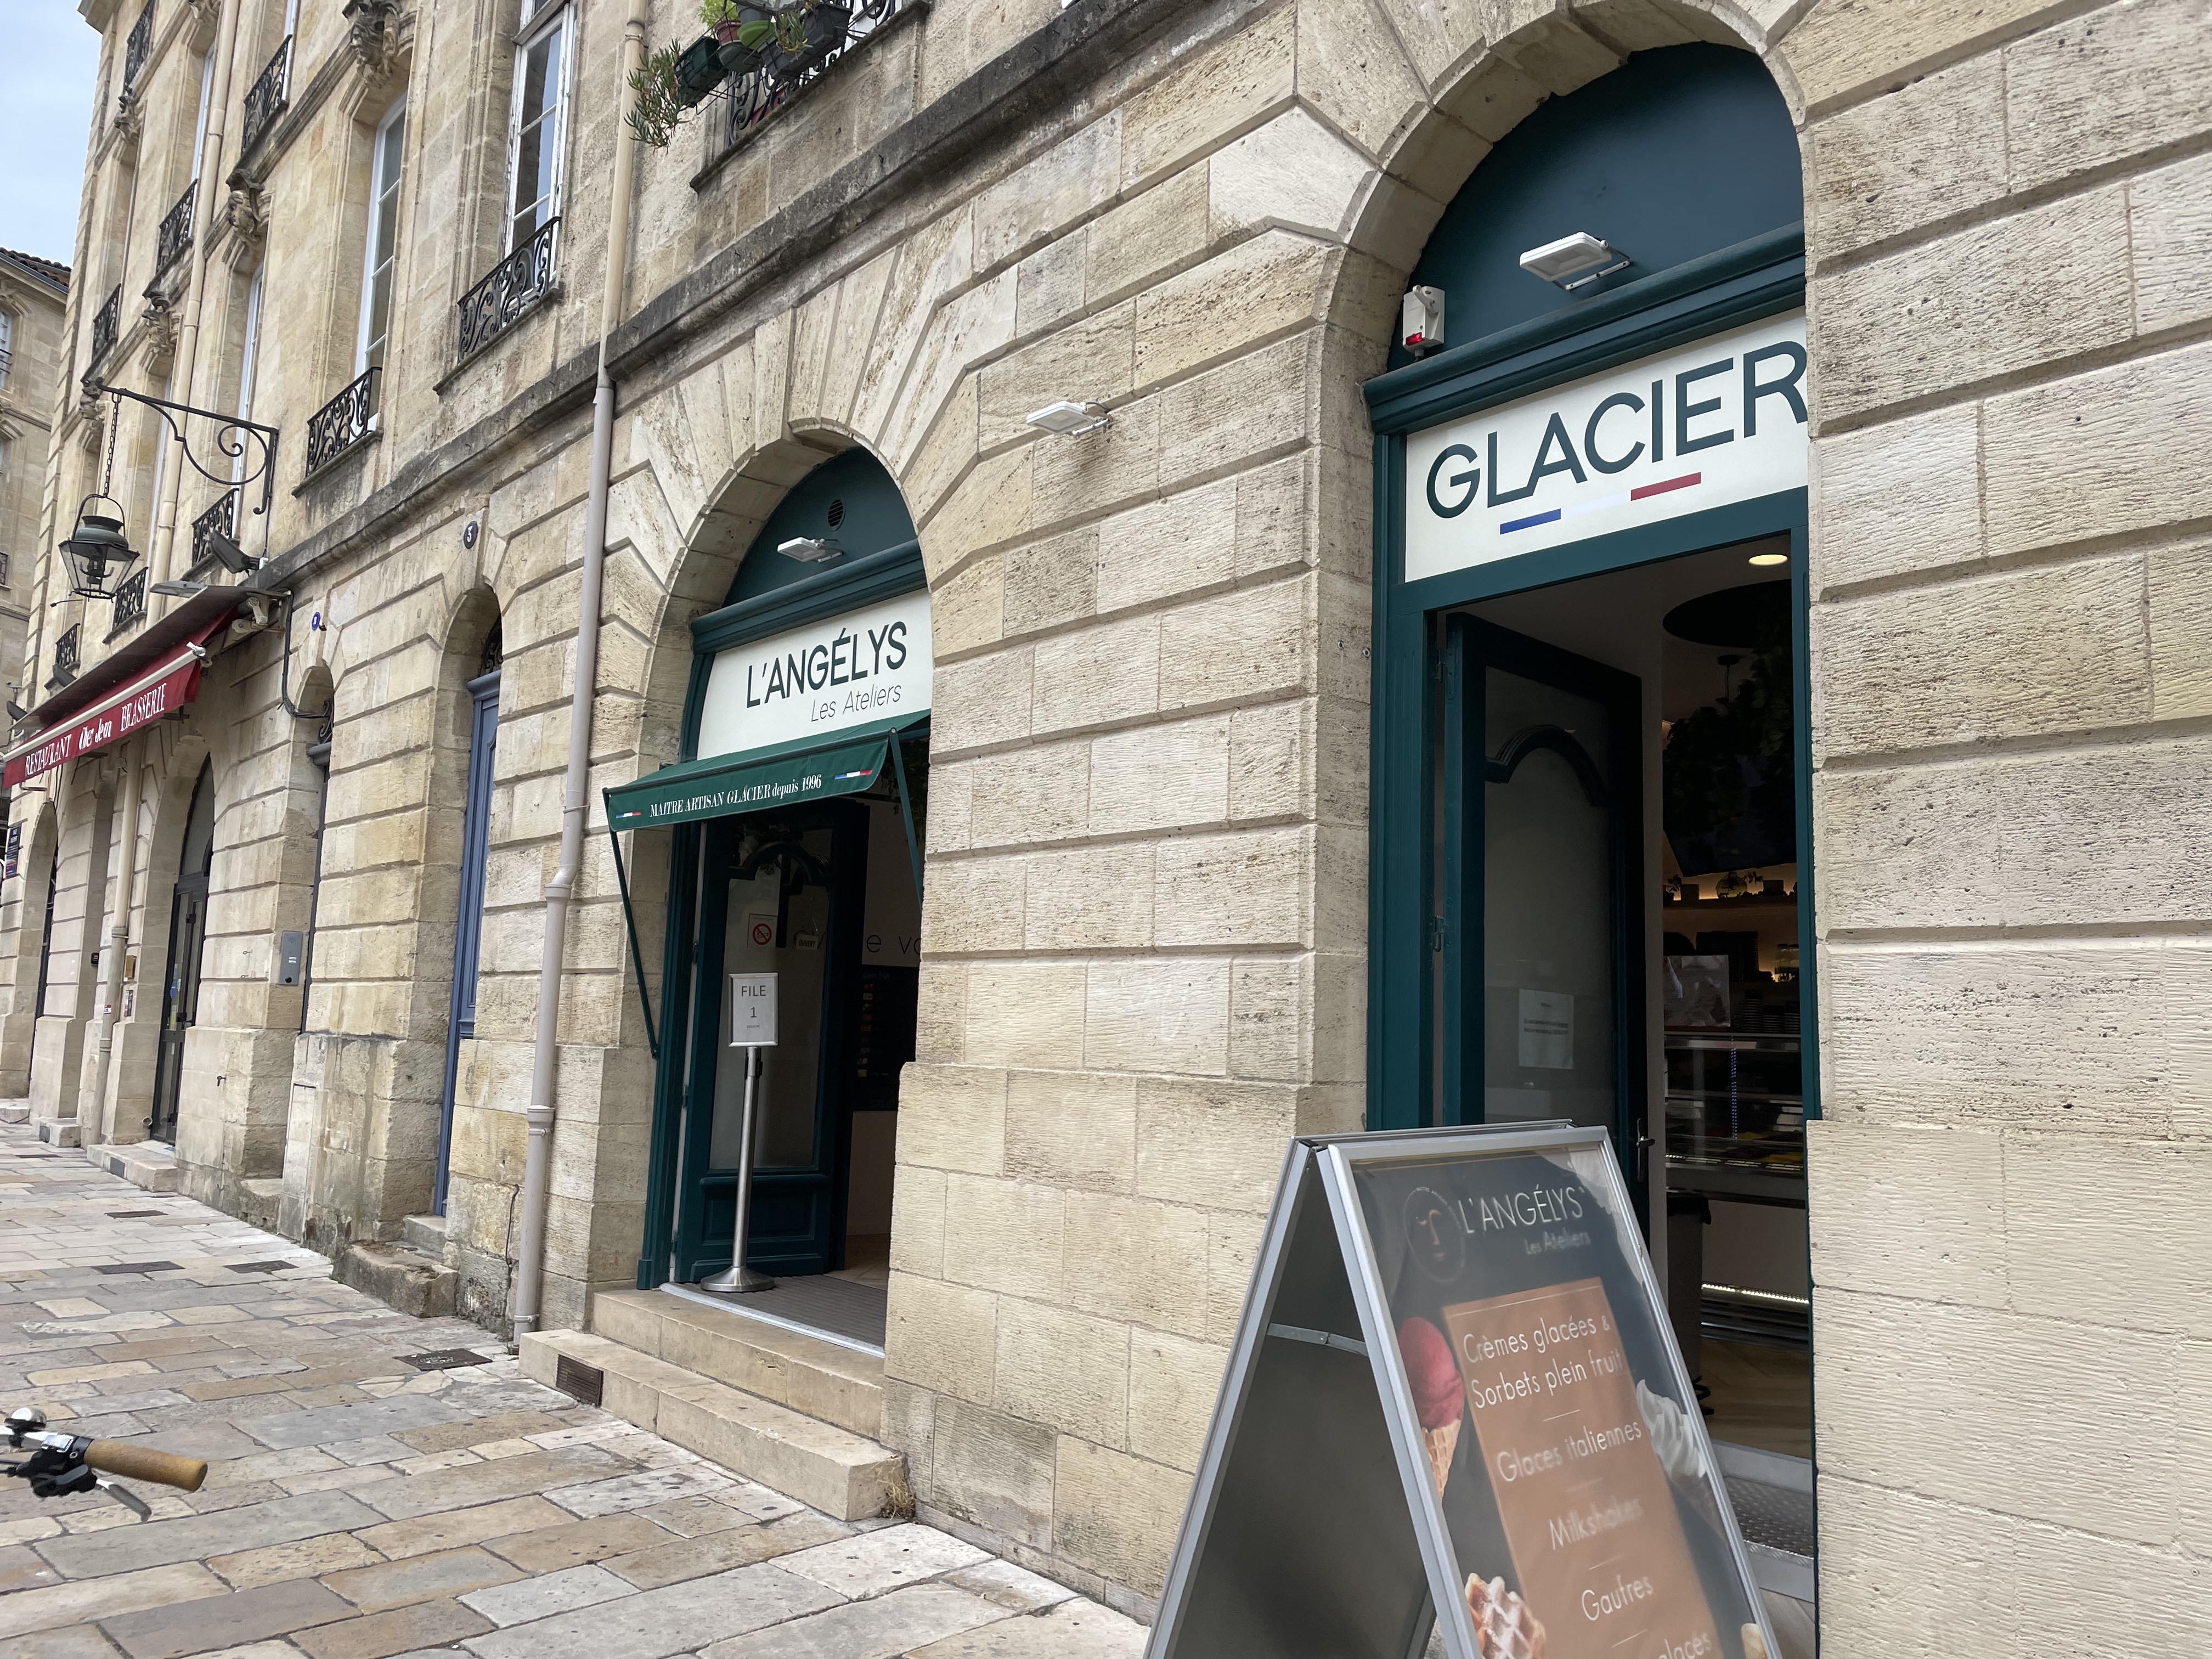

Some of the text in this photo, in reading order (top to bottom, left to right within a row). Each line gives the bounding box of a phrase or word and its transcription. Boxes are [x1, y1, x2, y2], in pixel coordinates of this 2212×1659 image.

[1426, 340, 1808, 519] GLACIER
[467, 525, 473, 543] 3
[747, 621, 907, 708] L'ANGÉLYS
[811, 684, 901, 722] Les Ateliers
[25, 734, 72, 776] RESTAURANT
[120, 682, 167, 732] BRASSERIE
[650, 774, 822, 817] MAITRE ARTISAN GLACIER depuis 1996
[798, 939, 816, 949] OUVERT
[741, 985, 766, 997] FILE
[750, 1006, 757, 1018] 1
[1458, 1183, 1583, 1234] L'ANGÉLYS
[1524, 1227, 1591, 1255] Les Ateliers
[1463, 1315, 1611, 1363] Crèmes glacées &
[1471, 1371, 1541, 1409] Sorbets
[1544, 1358, 1588, 1396] plein
[1497, 1421, 1642, 1482] Glaces italiennes
[1581, 1574, 1654, 1621] Gaufres
